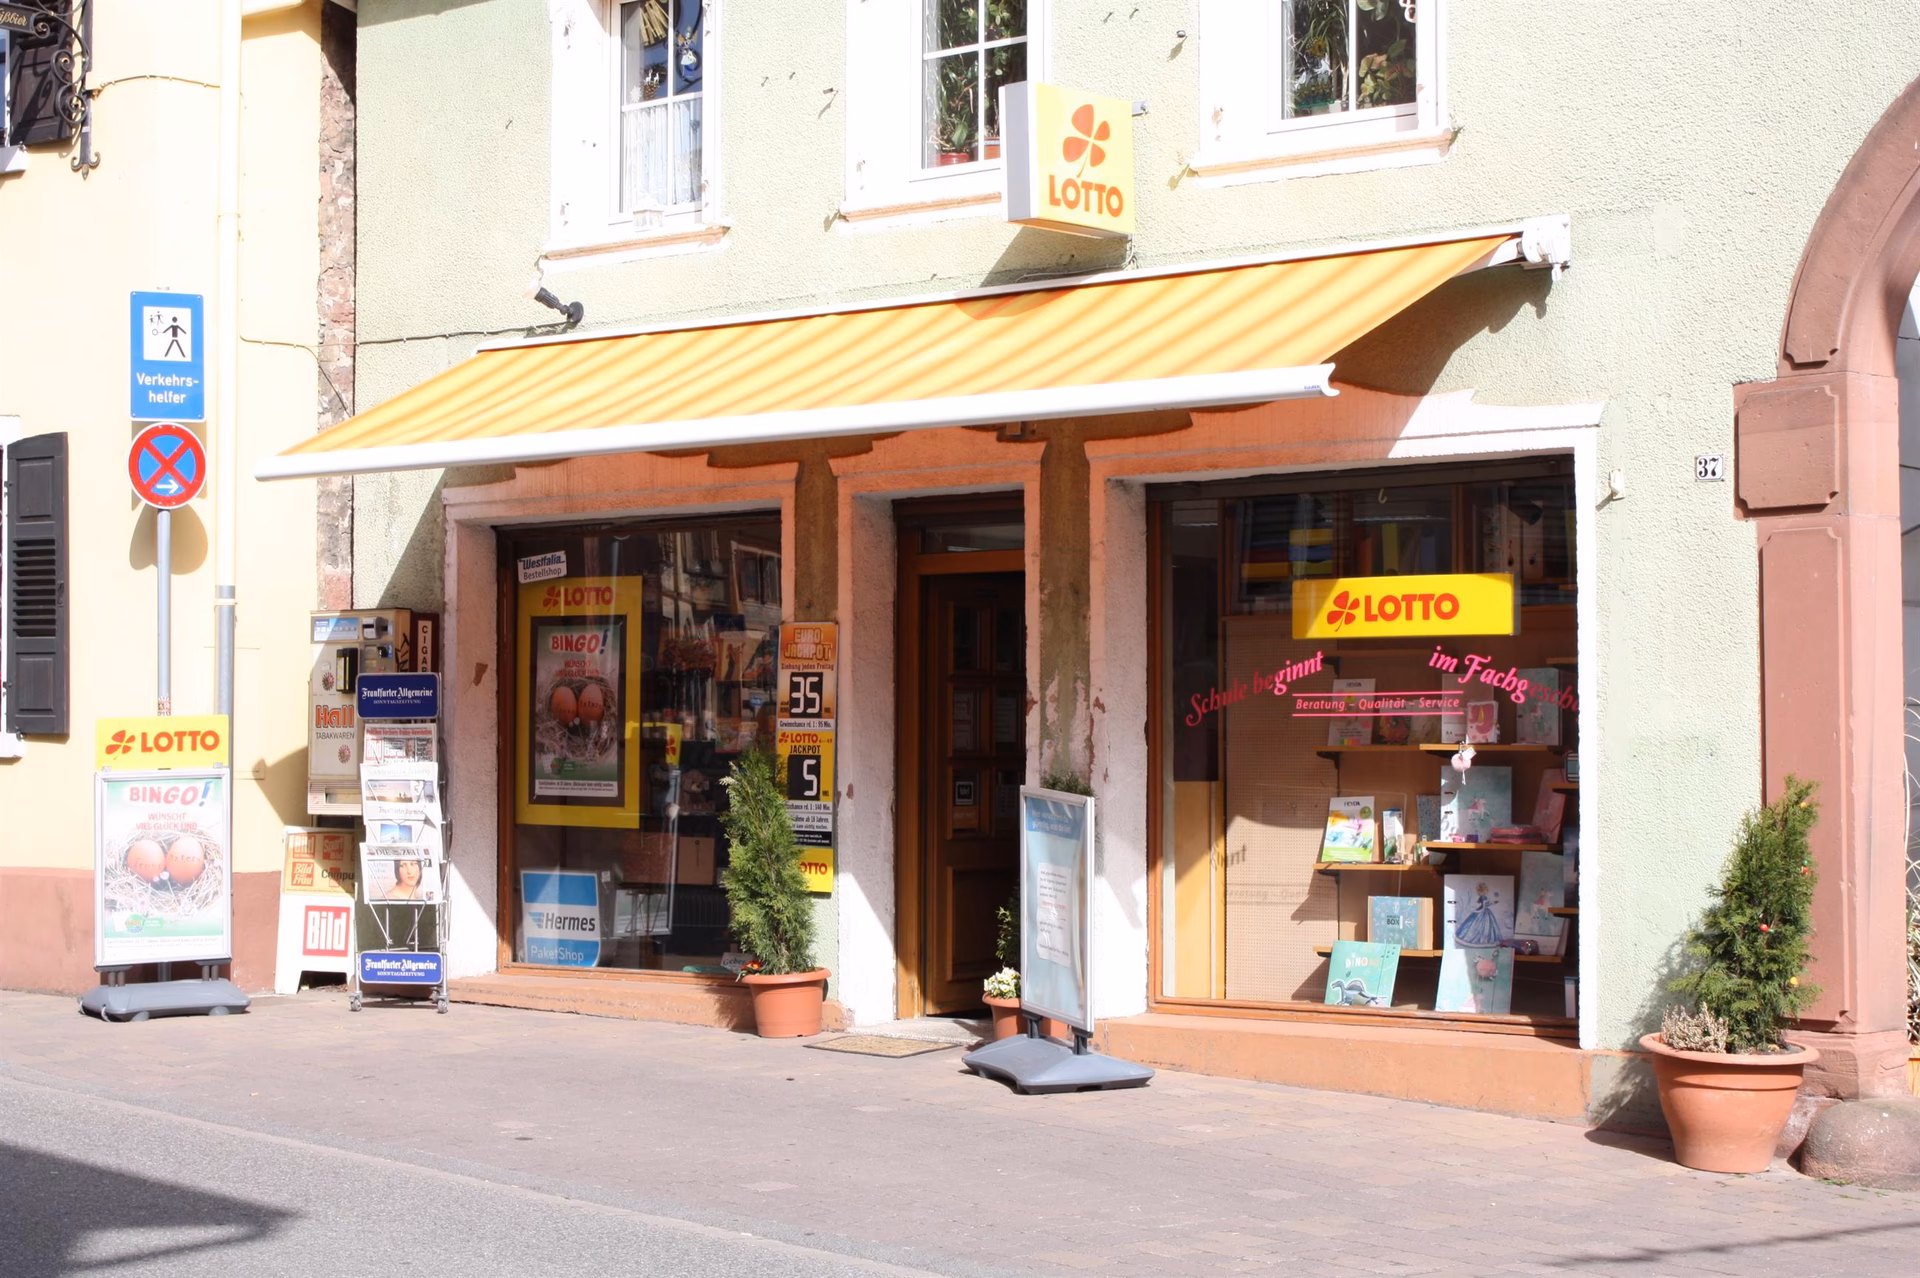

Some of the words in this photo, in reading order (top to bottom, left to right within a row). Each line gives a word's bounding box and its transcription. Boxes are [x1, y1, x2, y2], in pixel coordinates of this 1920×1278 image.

[1048, 174, 1123, 218] LOTTO
[136, 372, 199, 388] Verkehrs-
[148, 390, 186, 404] helfer
[1698, 457, 1719, 478] 37
[520, 554, 565, 570] Westfalia
[523, 567, 562, 580] Bestellshop
[564, 586, 614, 606] LOTTO
[1364, 593, 1460, 622] LOTTO
[551, 628, 610, 655] BINGO!
[794, 628, 822, 643] EURO
[784, 643, 831, 661] JACKPOT
[1428, 645, 1459, 673] im
[781, 663, 800, 671] Ziehung
[802, 663, 815, 671] jeden
[817, 663, 834, 671] Freitag
[361, 687, 397, 700] Frankfurter
[397, 687, 433, 699] Allgemeine
[791, 677, 820, 713] 35
[1185, 677, 1248, 727] Schule
[1252, 651, 1323, 696] beginnt
[1296, 699, 1345, 712] Beratung
[1359, 697, 1405, 710] Qualität
[1419, 697, 1459, 708] Service
[316, 705, 354, 728] Hall
[141, 730, 220, 753] LOTTO
[790, 734, 818, 744] LOTTO
[790, 745, 821, 754] JACKPOT
[803, 759, 817, 797] 5
[129, 780, 213, 807] BINGO!
[148, 811, 187, 820] WÜNSCHT
[136, 822, 151, 830] VIEL
[154, 821, 179, 830] GLÜCK
[180, 822, 197, 831] UND
[294, 863, 313, 874] Bild
[800, 862, 828, 875] OTTO
[293, 875, 313, 885] Frau
[545, 912, 595, 931] Hermes
[306, 910, 347, 951] Bild
[531, 945, 584, 964] PaketShop
[365, 958, 401, 971] Frankfurter
[401, 959, 437, 971] Allgemeine
